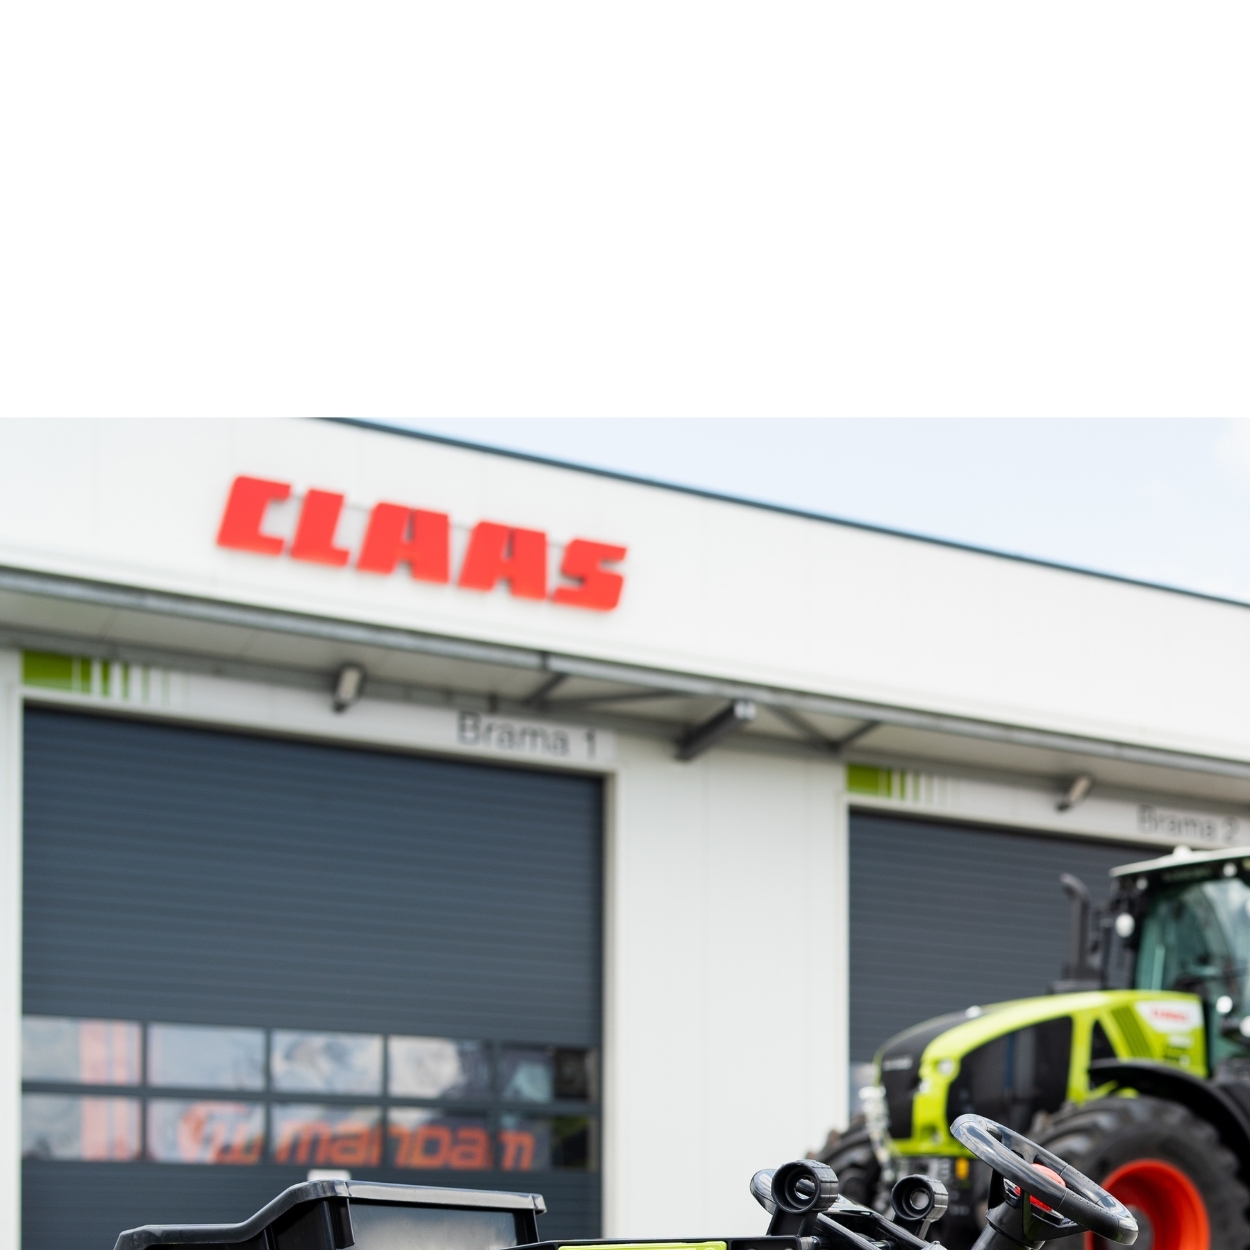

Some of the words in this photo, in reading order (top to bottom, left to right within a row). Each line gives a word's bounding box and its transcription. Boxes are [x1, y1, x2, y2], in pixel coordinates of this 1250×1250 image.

[216, 475, 628, 612] CLAAS
[457, 709, 570, 758] Brama
[583, 725, 597, 761] 1
[1138, 803, 1218, 842] Brama
[1222, 815, 1240, 845] 2
